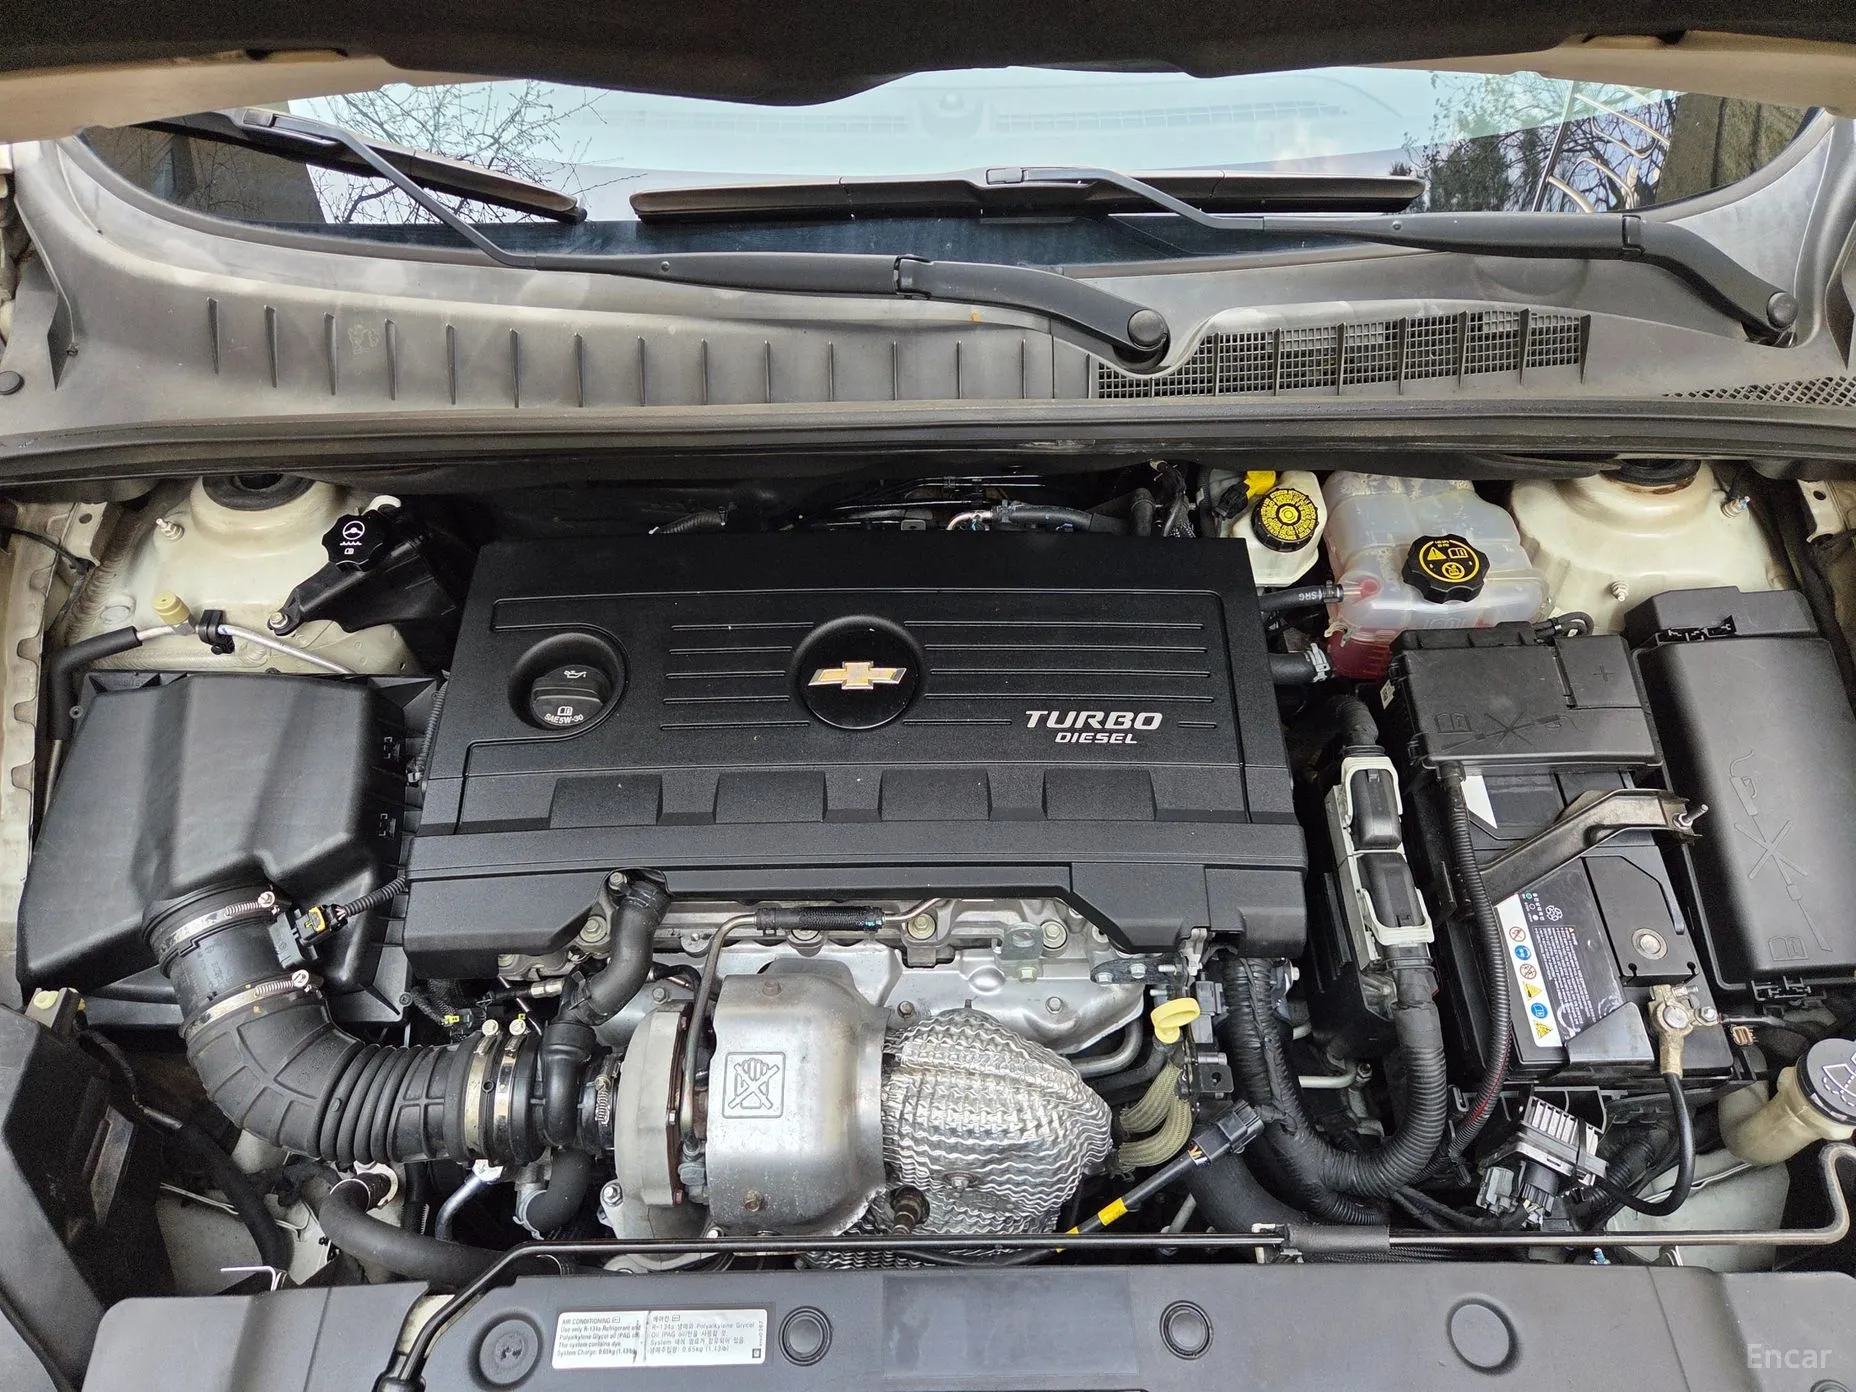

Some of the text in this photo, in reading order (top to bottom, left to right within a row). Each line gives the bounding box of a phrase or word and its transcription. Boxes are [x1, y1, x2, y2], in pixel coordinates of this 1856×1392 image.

[544, 713, 584, 724] SAE 5W-30
[1025, 710, 1164, 730] TURBO
[1054, 732, 1138, 744] DIESEL
[592, 1333, 609, 1341] Glycol
